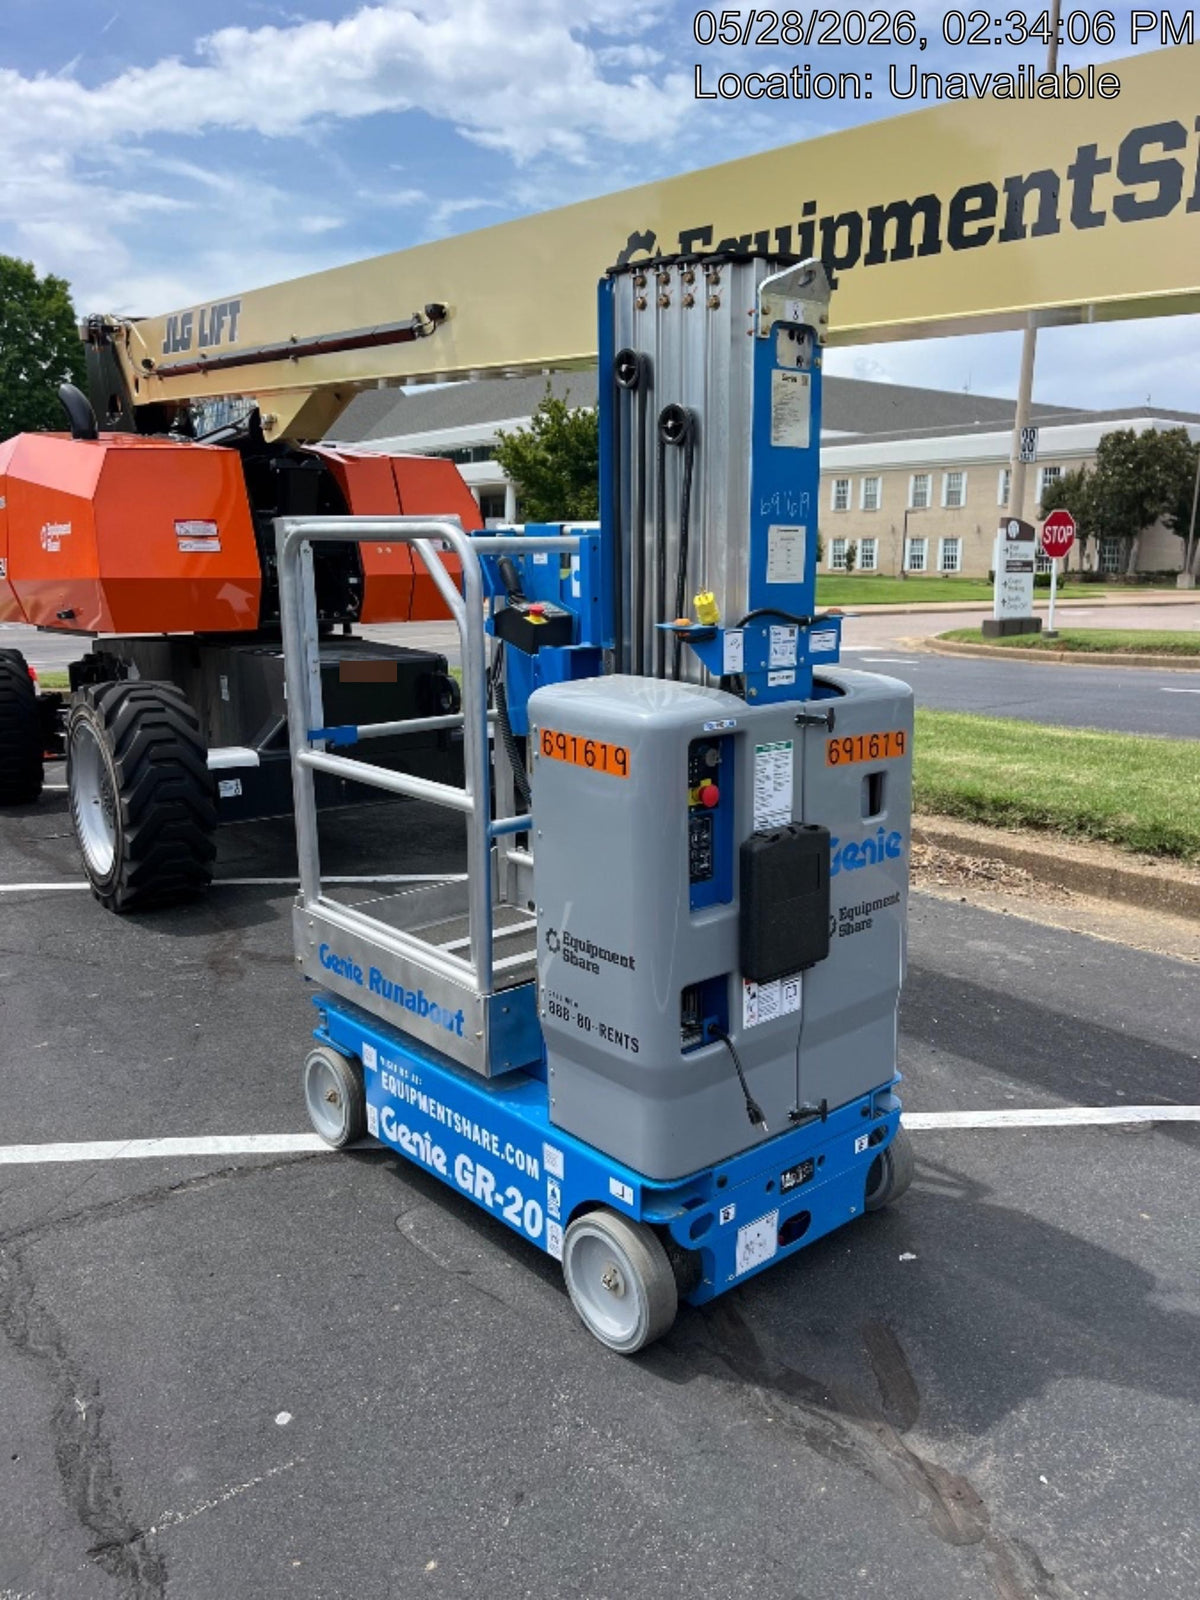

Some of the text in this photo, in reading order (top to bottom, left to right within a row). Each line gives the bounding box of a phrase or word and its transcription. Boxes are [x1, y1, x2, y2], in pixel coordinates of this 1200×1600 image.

[162, 300, 241, 355] JLG LIFT
[1043, 525, 1073, 544] STOP
[542, 730, 627, 776] 691619
[829, 731, 905, 765] 691619
[838, 892, 901, 921] Equipment
[838, 917, 873, 938] Share
[562, 931, 636, 971] Equipment
[562, 948, 600, 975] Share
[318, 943, 465, 1037] Genie Runabout
[381, 1071, 540, 1181] EQUIPMENTSHARE.COM
[380, 1105, 447, 1175] Genie
[454, 1153, 543, 1239] GR-20
